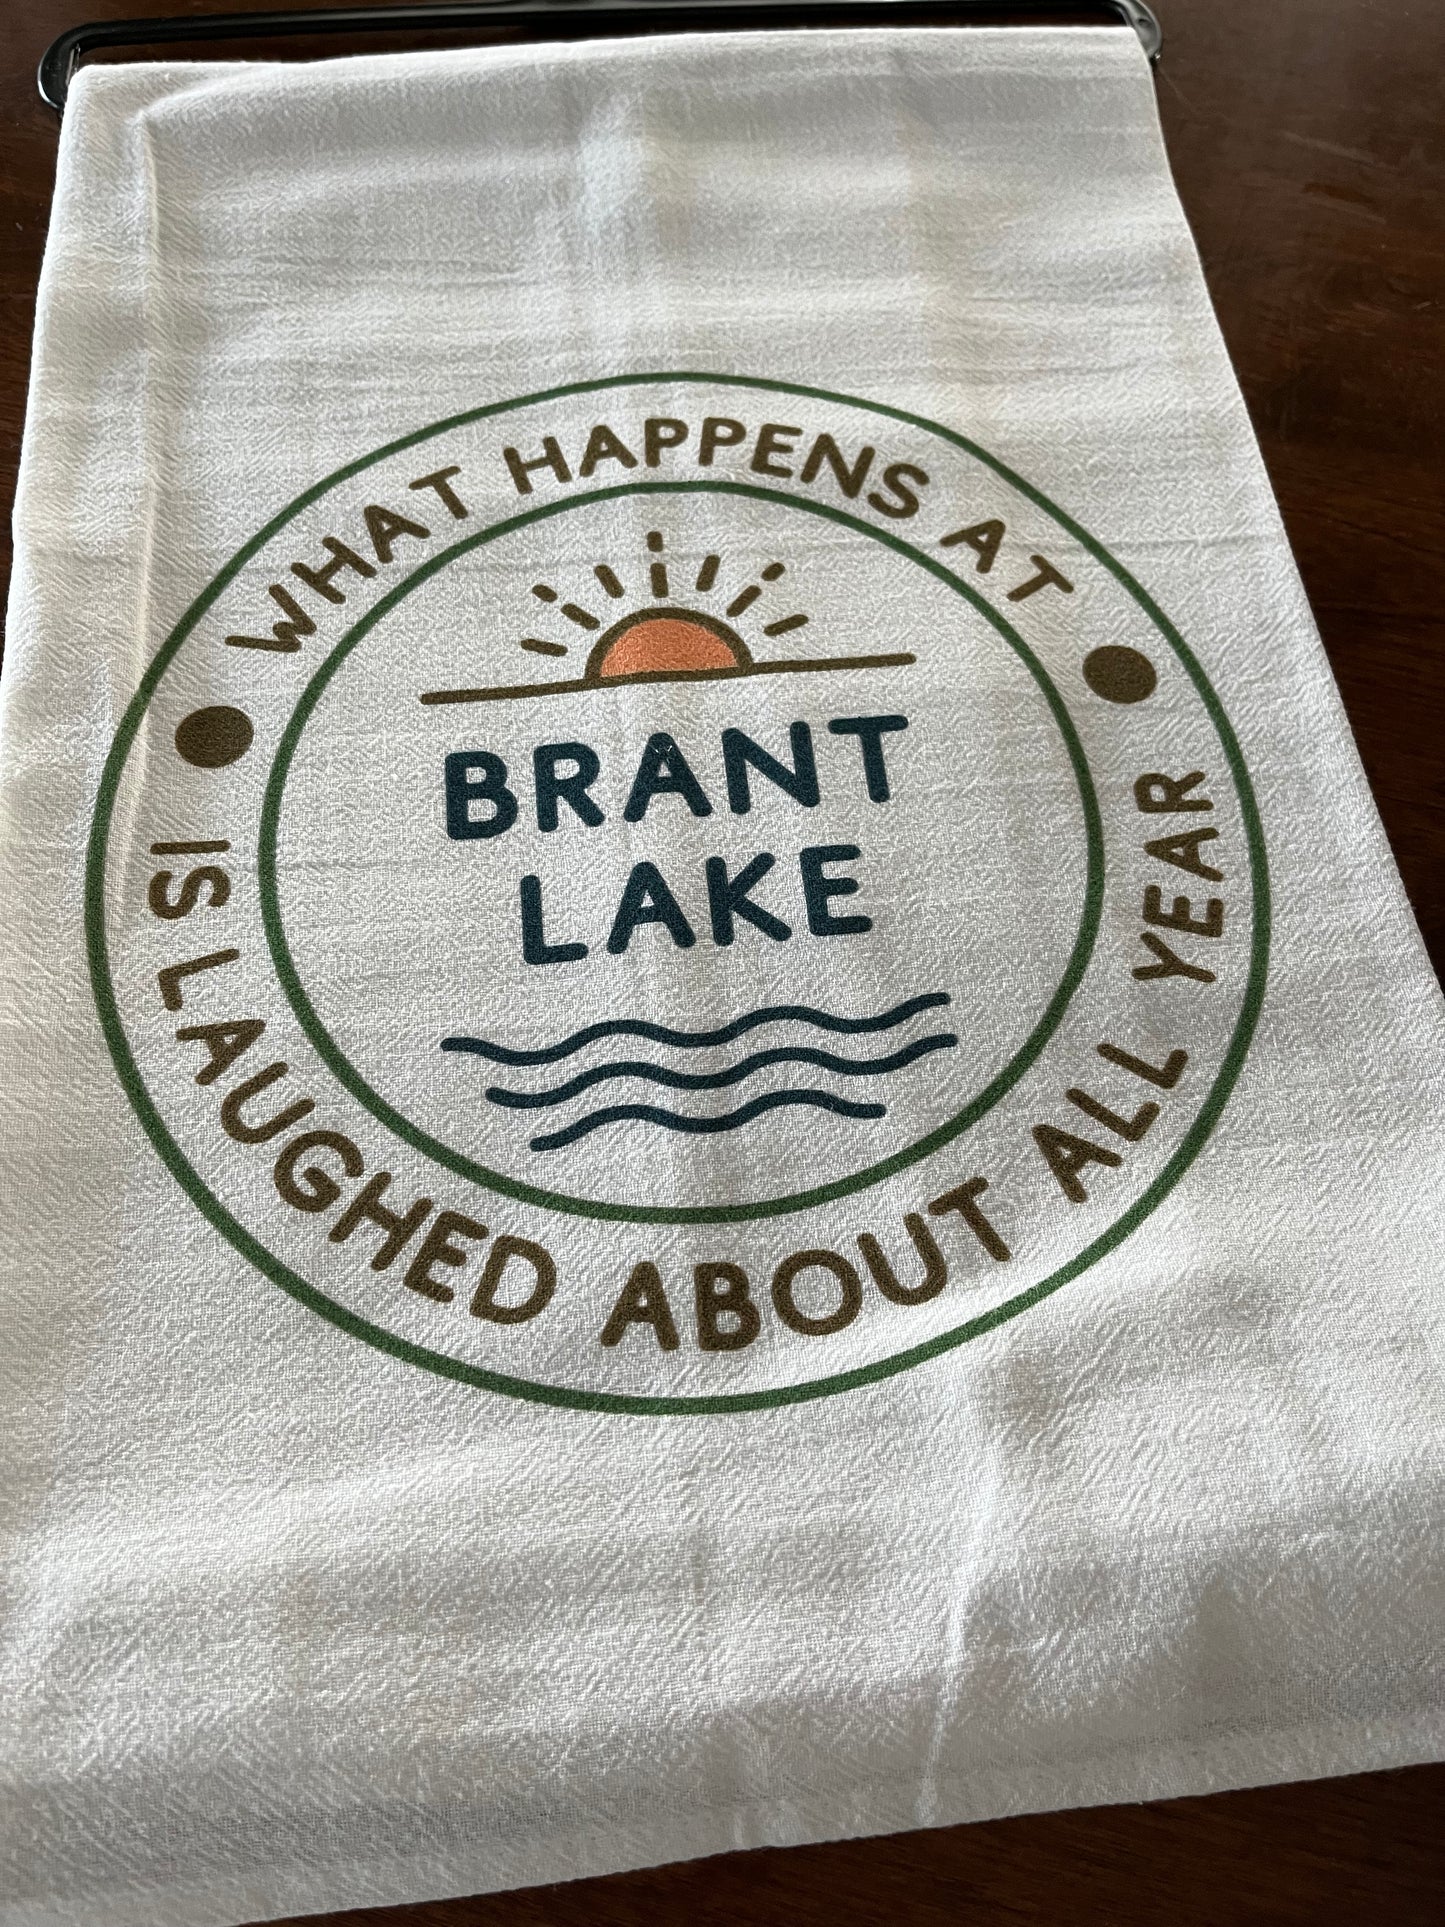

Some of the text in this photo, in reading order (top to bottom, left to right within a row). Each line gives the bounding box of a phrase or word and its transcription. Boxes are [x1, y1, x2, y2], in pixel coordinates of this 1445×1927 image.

[226, 417, 1074, 654] WHAT HAPPENS AT
[444, 714, 909, 841] BRANT
[520, 844, 874, 965] LAKE
[148, 770, 1228, 1353] IS LAUGHED ABOUT ALL YEAR
